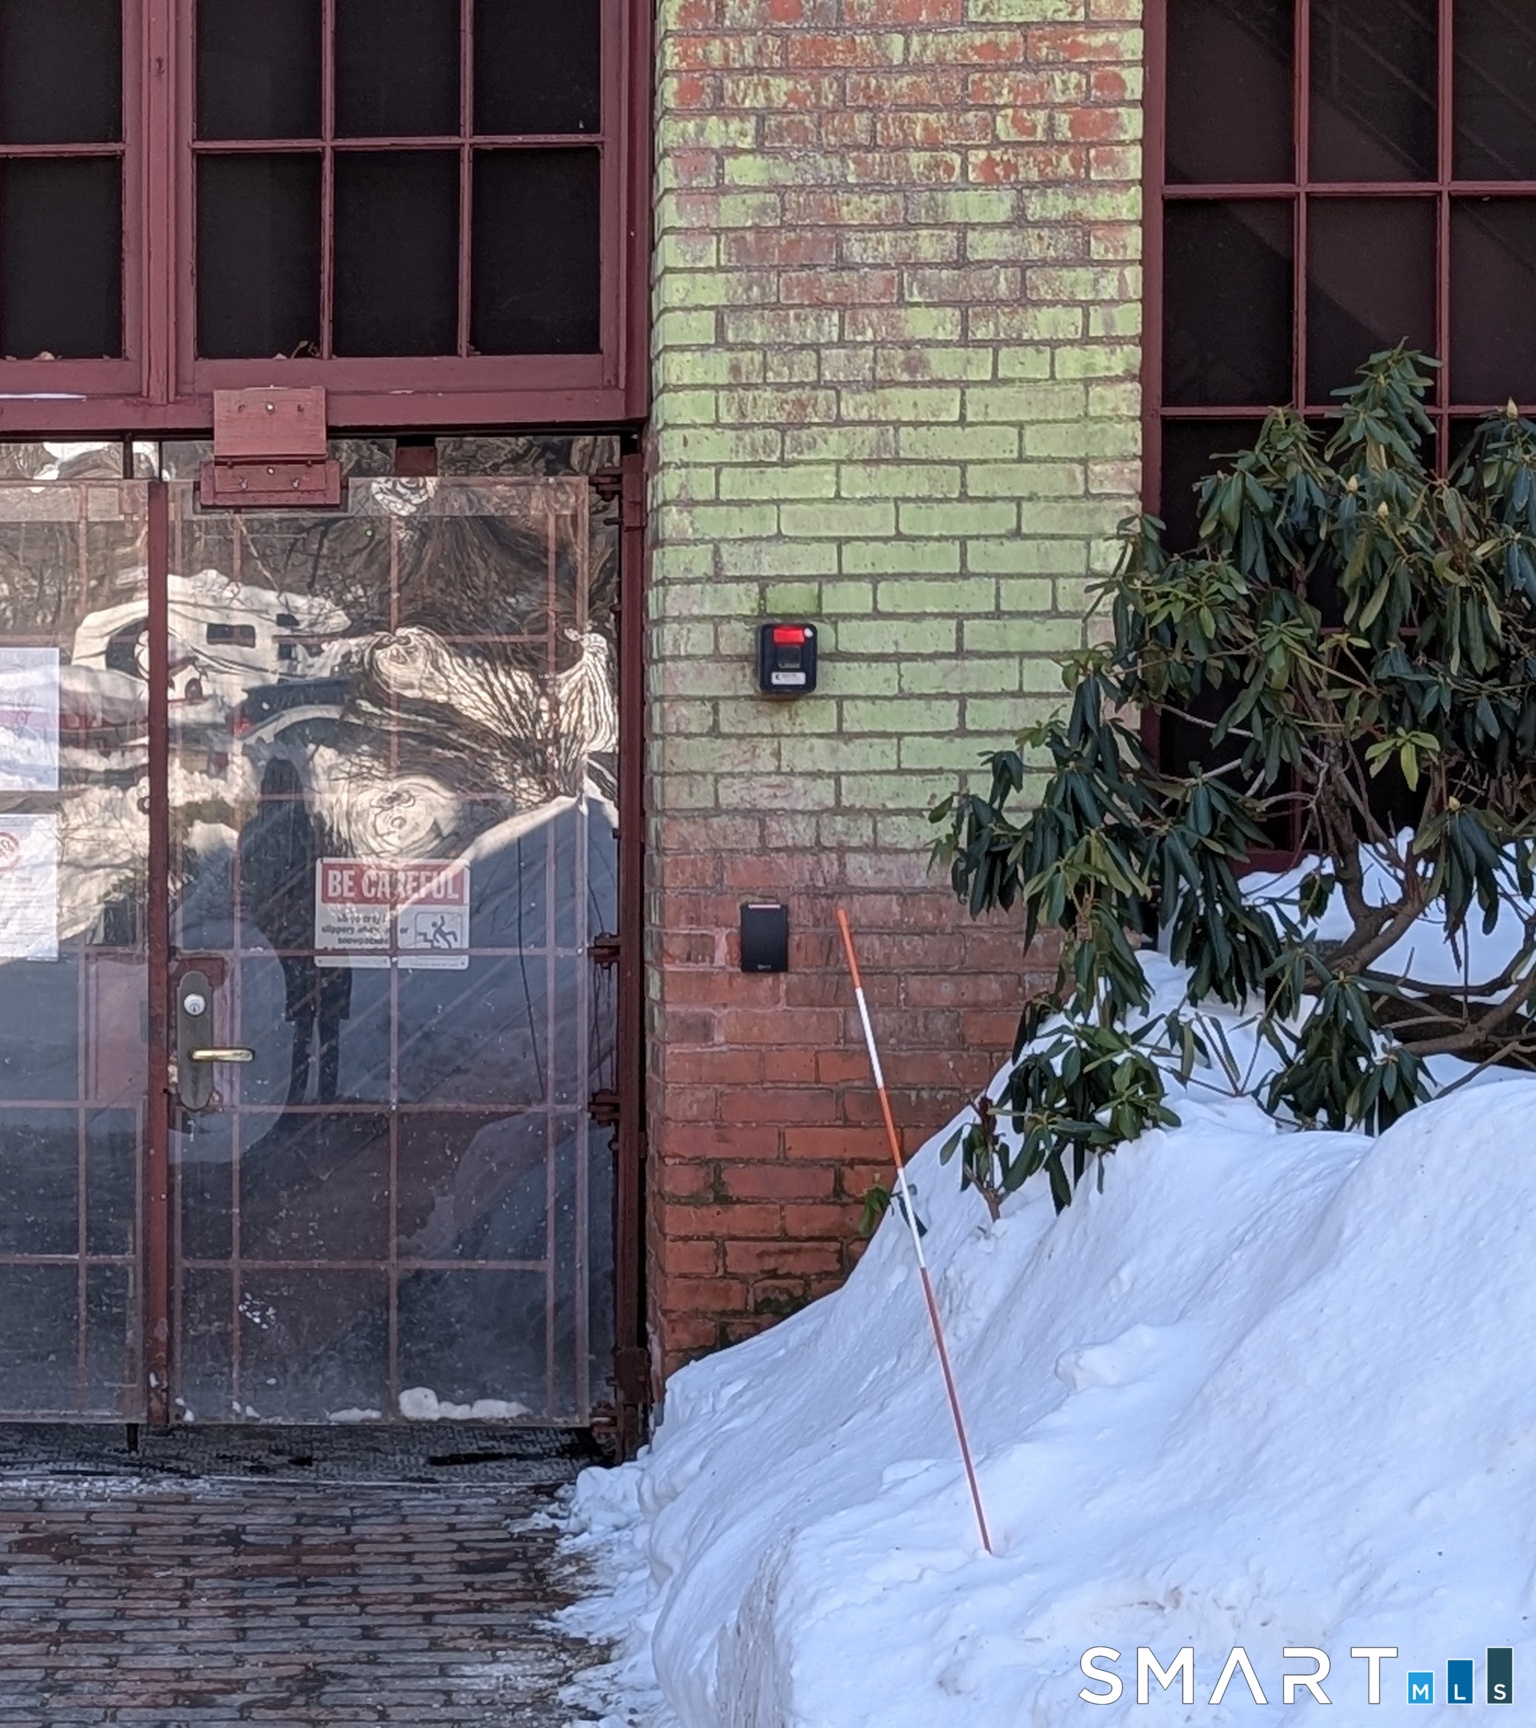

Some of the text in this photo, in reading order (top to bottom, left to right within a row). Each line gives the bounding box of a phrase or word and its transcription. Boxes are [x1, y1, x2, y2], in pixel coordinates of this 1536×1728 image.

[327, 869, 459, 899] BE CAREFUL
[321, 925, 355, 934] slippery
